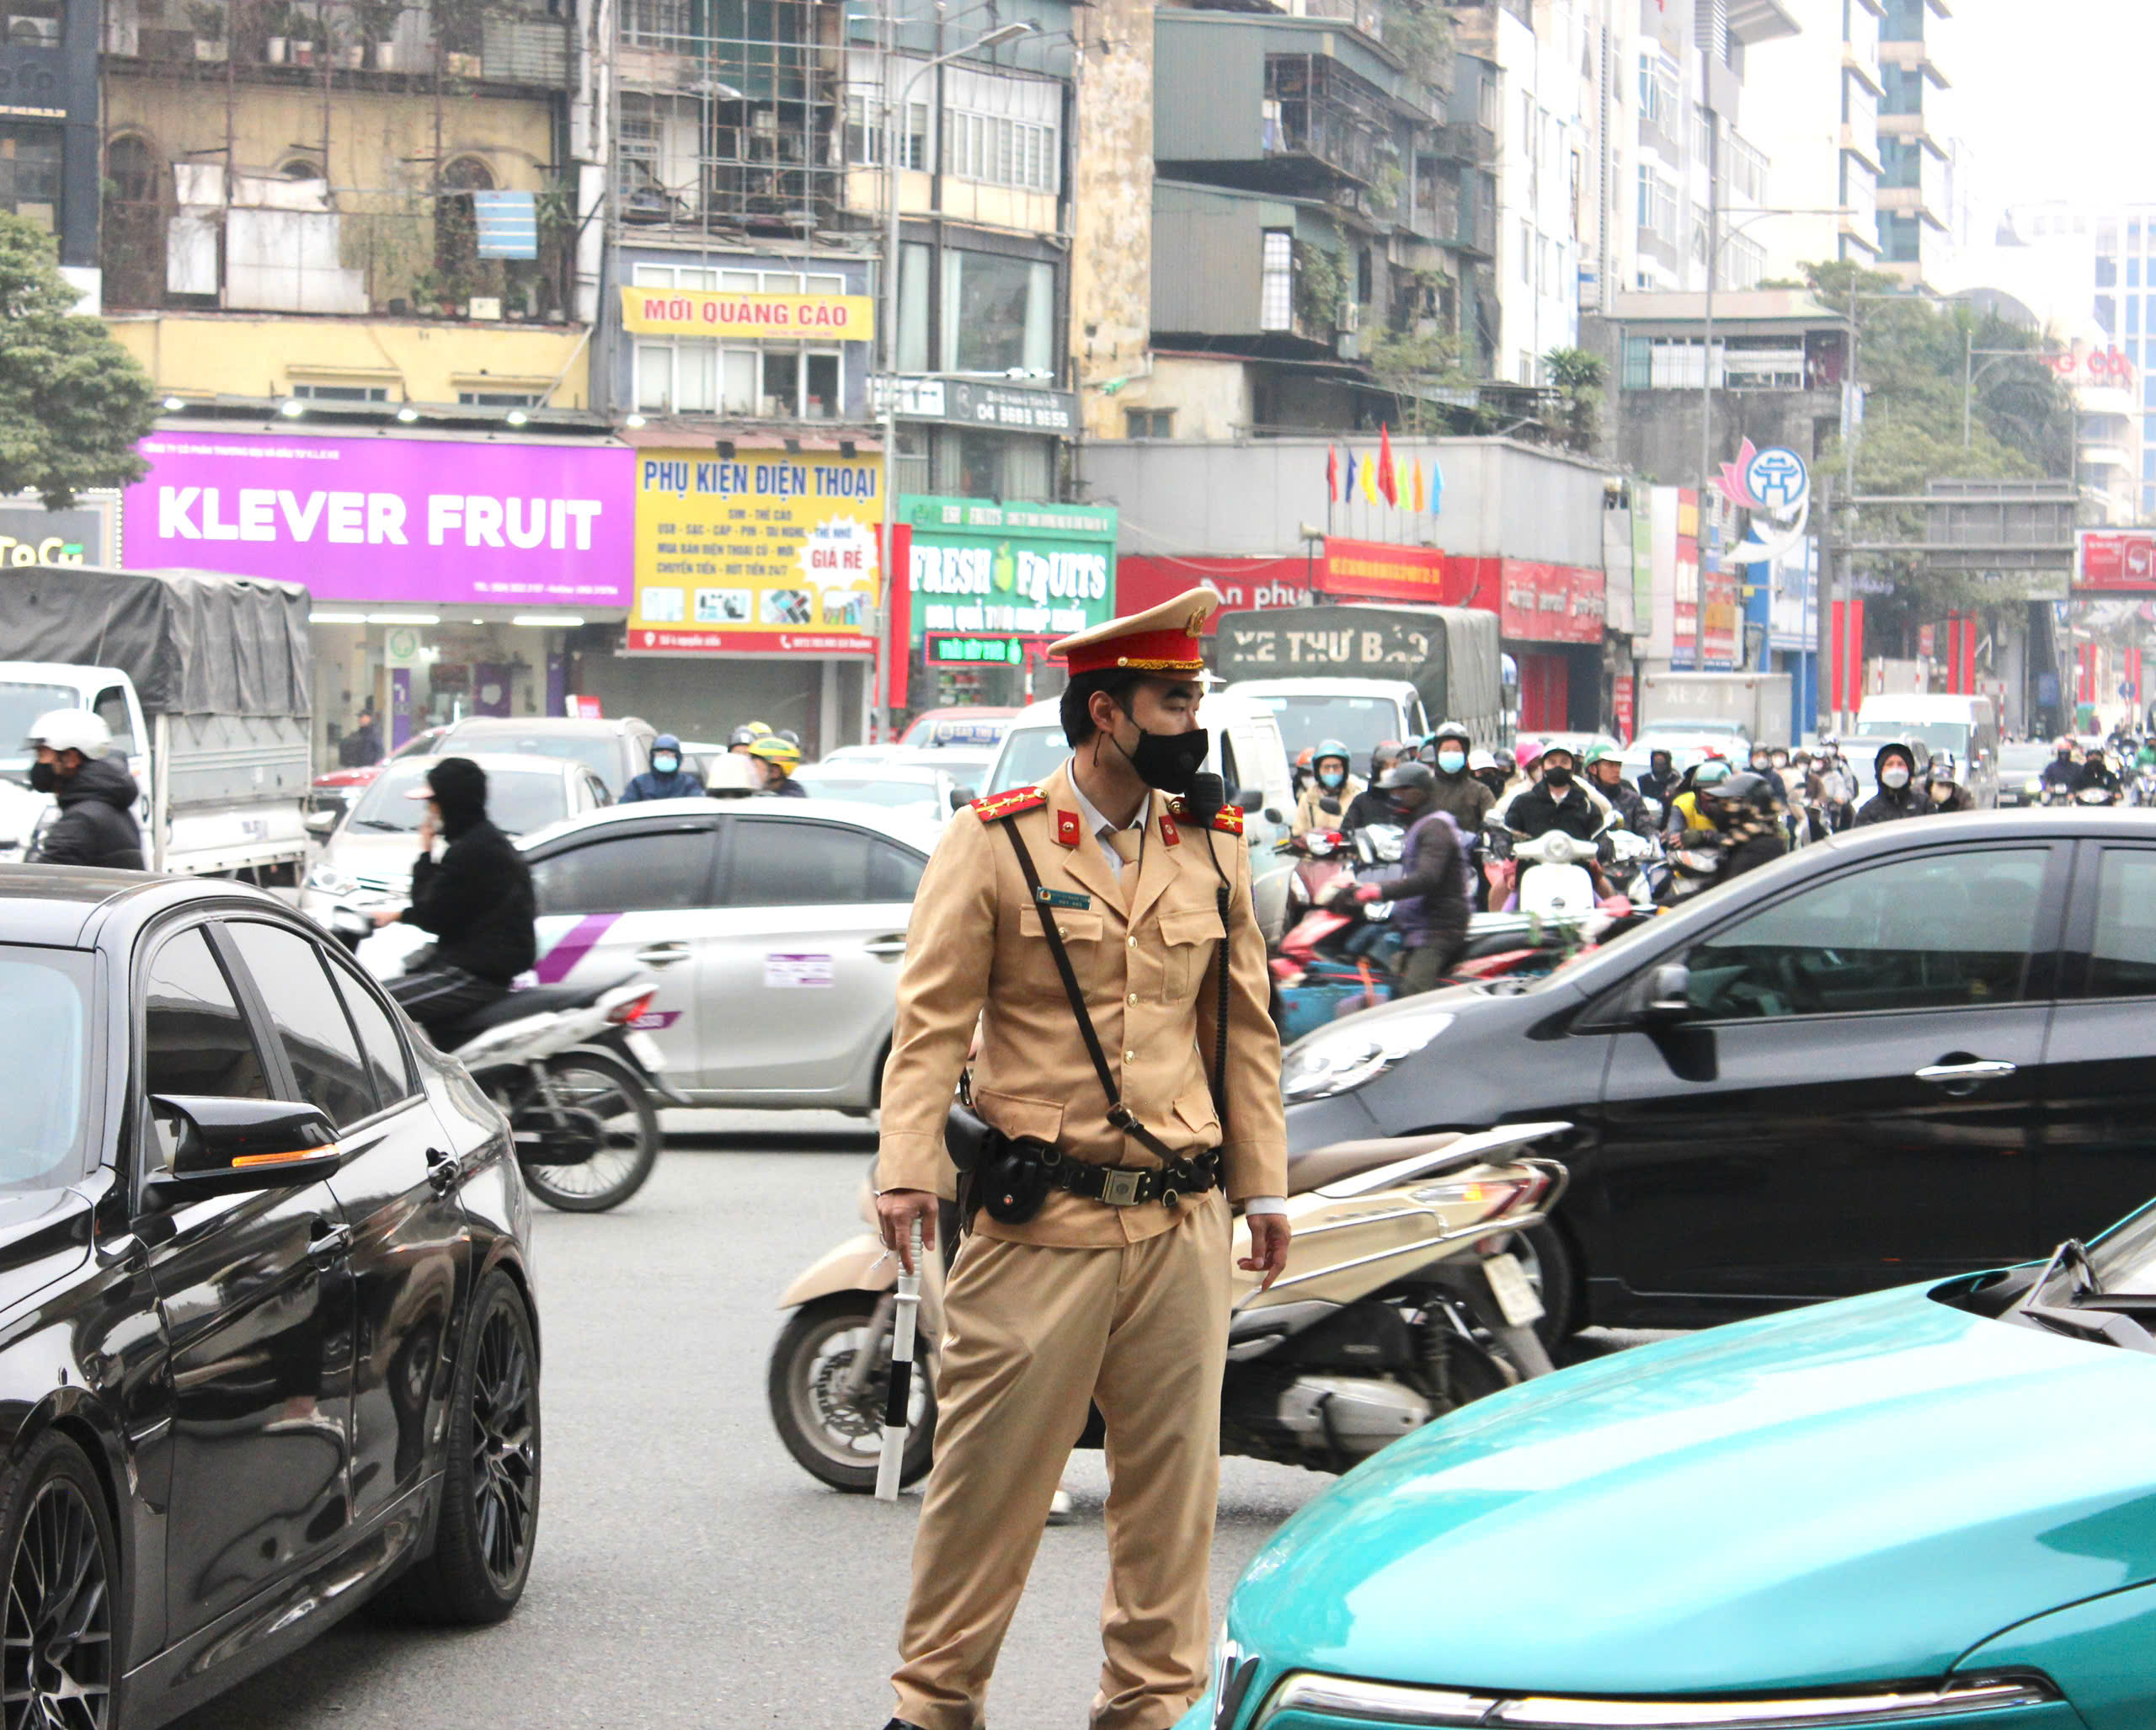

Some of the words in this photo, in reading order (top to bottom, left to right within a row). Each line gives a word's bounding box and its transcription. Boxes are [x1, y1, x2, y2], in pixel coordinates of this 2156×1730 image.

[798, 301, 848, 327] CÁO
[643, 462, 688, 498] PHỤ
[696, 457, 749, 500] KIỆN
[755, 459, 806, 502] ĐIỆN
[814, 467, 876, 504] THOẠI
[159, 486, 409, 545] KLEVER
[428, 494, 602, 550] FRUIT
[811, 546, 838, 570] GIÁ
[843, 544, 863, 571] RẺ
[910, 545, 992, 595] FRESH
[1016, 550, 1107, 606] FRUITS
[1287, 628, 1355, 662] THƯ
